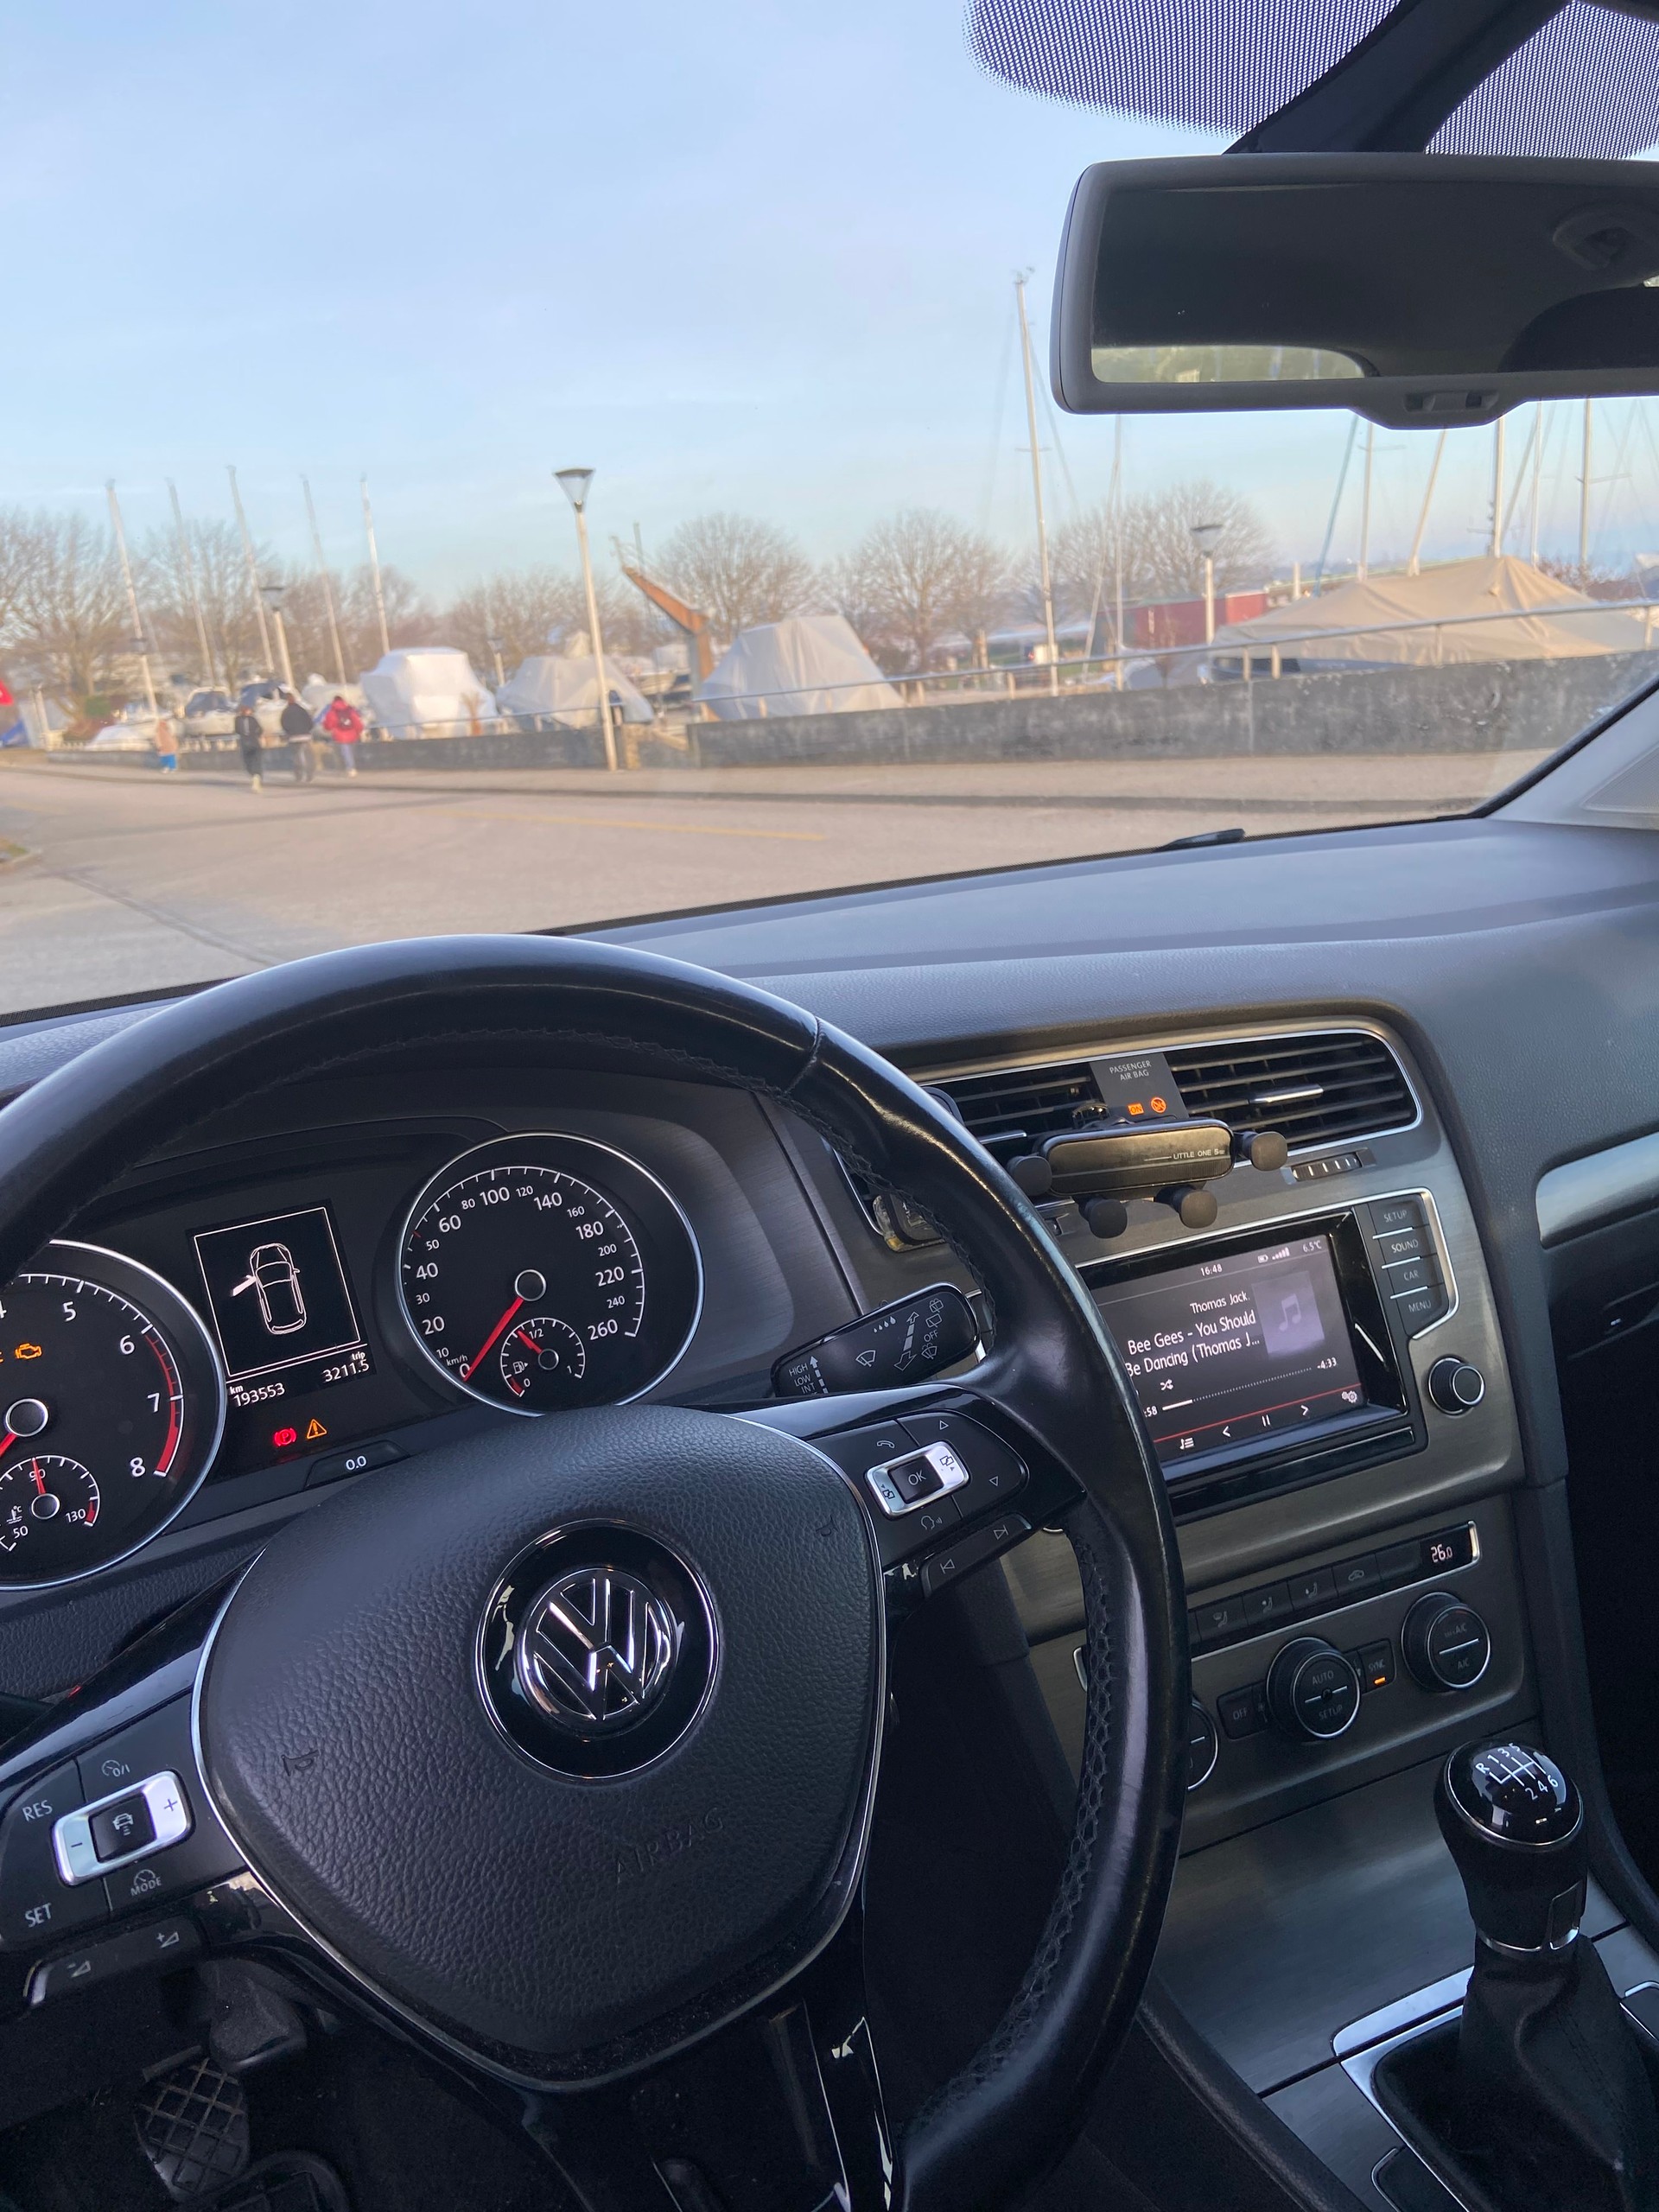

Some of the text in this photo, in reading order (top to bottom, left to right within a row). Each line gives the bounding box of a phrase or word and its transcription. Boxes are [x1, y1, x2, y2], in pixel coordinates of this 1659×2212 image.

[1109, 1060, 1152, 1074] PASSENGER
[1120, 1069, 1149, 1081] AIR BAG
[1129, 1105, 1142, 1114] ON
[480, 1187, 510, 1206] 100
[516, 1185, 533, 1198] 120
[461, 1198, 475, 1210] 80
[534, 1192, 562, 1211] 140
[567, 1205, 585, 1217] 160
[1383, 1210, 1408, 1223] SETUP
[439, 1215, 461, 1233] 60
[575, 1221, 604, 1240] 180
[426, 1239, 440, 1250] 50
[598, 1243, 617, 1256] 200
[1302, 1240, 1322, 1253] 6.5°C
[1391, 1239, 1419, 1253] SOUND
[416, 1262, 438, 1281] 40
[1200, 1264, 1223, 1276] 16:48
[1403, 1269, 1419, 1281] CAR
[595, 1267, 624, 1287] 220
[416, 1293, 430, 1305] 30
[607, 1296, 626, 1308] 240
[1190, 1297, 1226, 1314] Thomas
[62, 1301, 76, 1321] 5
[1408, 1300, 1431, 1313] MENU
[422, 1316, 445, 1335] 20
[588, 1319, 618, 1340] 260
[529, 1328, 544, 1339] 1/2
[924, 1330, 938, 1343] OFF
[1128, 1338, 1151, 1355] Bee
[1154, 1330, 1184, 1348] Gees
[1196, 1322, 1217, 1338] You
[1219, 1310, 1256, 1332] Should
[120, 1335, 135, 1355] 6
[351, 1351, 365, 1361] trip
[436, 1347, 449, 1358] 10
[1125, 1363, 1141, 1377] Be
[1144, 1351, 1189, 1373] Dancing
[1192, 1337, 1242, 1363] (Thomas
[447, 1355, 467, 1366] km/h
[1317, 1357, 1337, 1370] -4:33
[322, 1359, 369, 1382] 3211.5
[460, 1363, 471, 1378] 0
[788, 1363, 809, 1376] HIGH
[524, 1378, 531, 1388] 0
[794, 1374, 811, 1387] LOW
[230, 1385, 244, 1395] km
[234, 1382, 285, 1407] 193553
[801, 1382, 816, 1394] INT
[147, 1393, 161, 1413] 7
[1144, 1406, 1157, 1418] :58
[130, 1457, 146, 1478] 8
[346, 1455, 367, 1471] 0.0
[29, 1469, 46, 1482] 90
[908, 1470, 926, 1485] OK
[65, 1509, 86, 1522] 130
[13, 1525, 29, 1538] 50
[1430, 1543, 1452, 1563] 26.0
[1369, 1659, 1386, 1672] SYNC
[1313, 1670, 1334, 1685] AUTO
[1233, 1707, 1249, 1720] OFF
[1319, 1705, 1344, 1720] SETUP
[1497, 1748, 1510, 1758] 3
[1509, 1742, 1521, 1752] 5
[1487, 1754, 1499, 1764] 1
[1476, 1763, 1490, 1774] R
[1538, 1780, 1548, 1793] 4
[1548, 1775, 1559, 1788] 6
[1525, 1787, 1538, 1801] 2
[22, 1800, 53, 1821] RES
[616, 1807, 724, 1885] AIRBAG
[130, 1876, 162, 1897] MODE
[24, 1903, 52, 1928] SET
